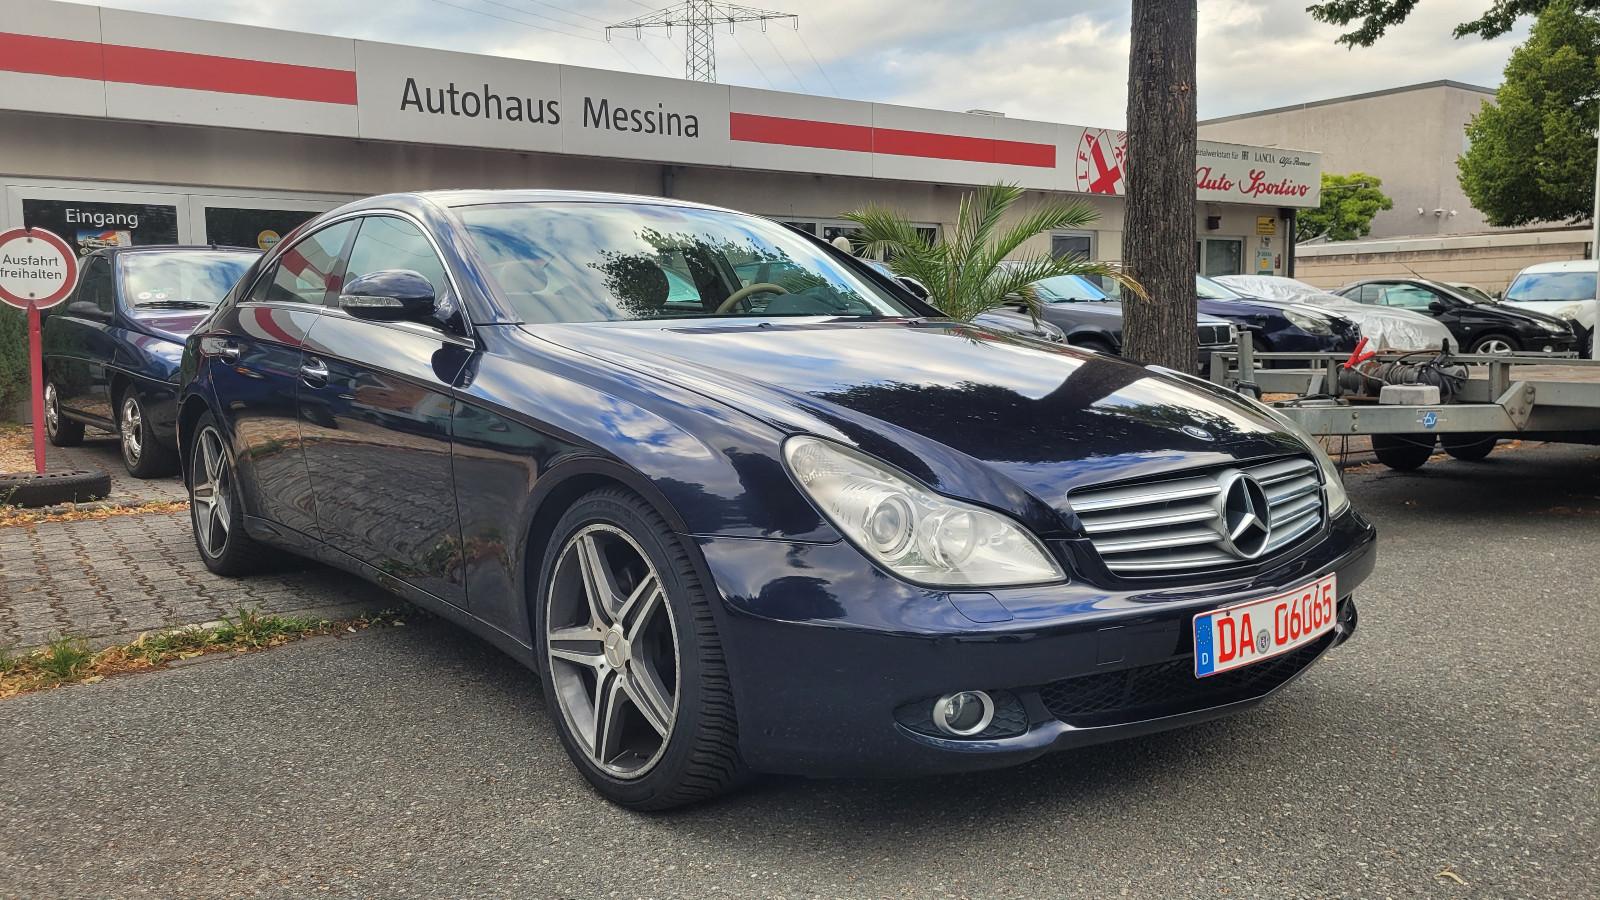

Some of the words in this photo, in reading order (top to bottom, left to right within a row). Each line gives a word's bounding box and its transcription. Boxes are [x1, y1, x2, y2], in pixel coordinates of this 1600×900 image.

[400, 77, 561, 125] Autohaus
[583, 96, 699, 138] Messina
[1078, 134, 1096, 192] LFA
[1195, 148, 1230, 159] ezialwerkstatt
[1254, 152, 1275, 163] LANCIA
[1196, 167, 1235, 191] Auto
[1239, 169, 1310, 198] Sportivo
[65, 208, 139, 229] Eingang
[2, 254, 59, 266] Ausfahrt
[0, 267, 62, 280] freihalten
[1217, 613, 1255, 663] DA
[1274, 584, 1331, 645] 06065
[1202, 653, 1209, 665] D
